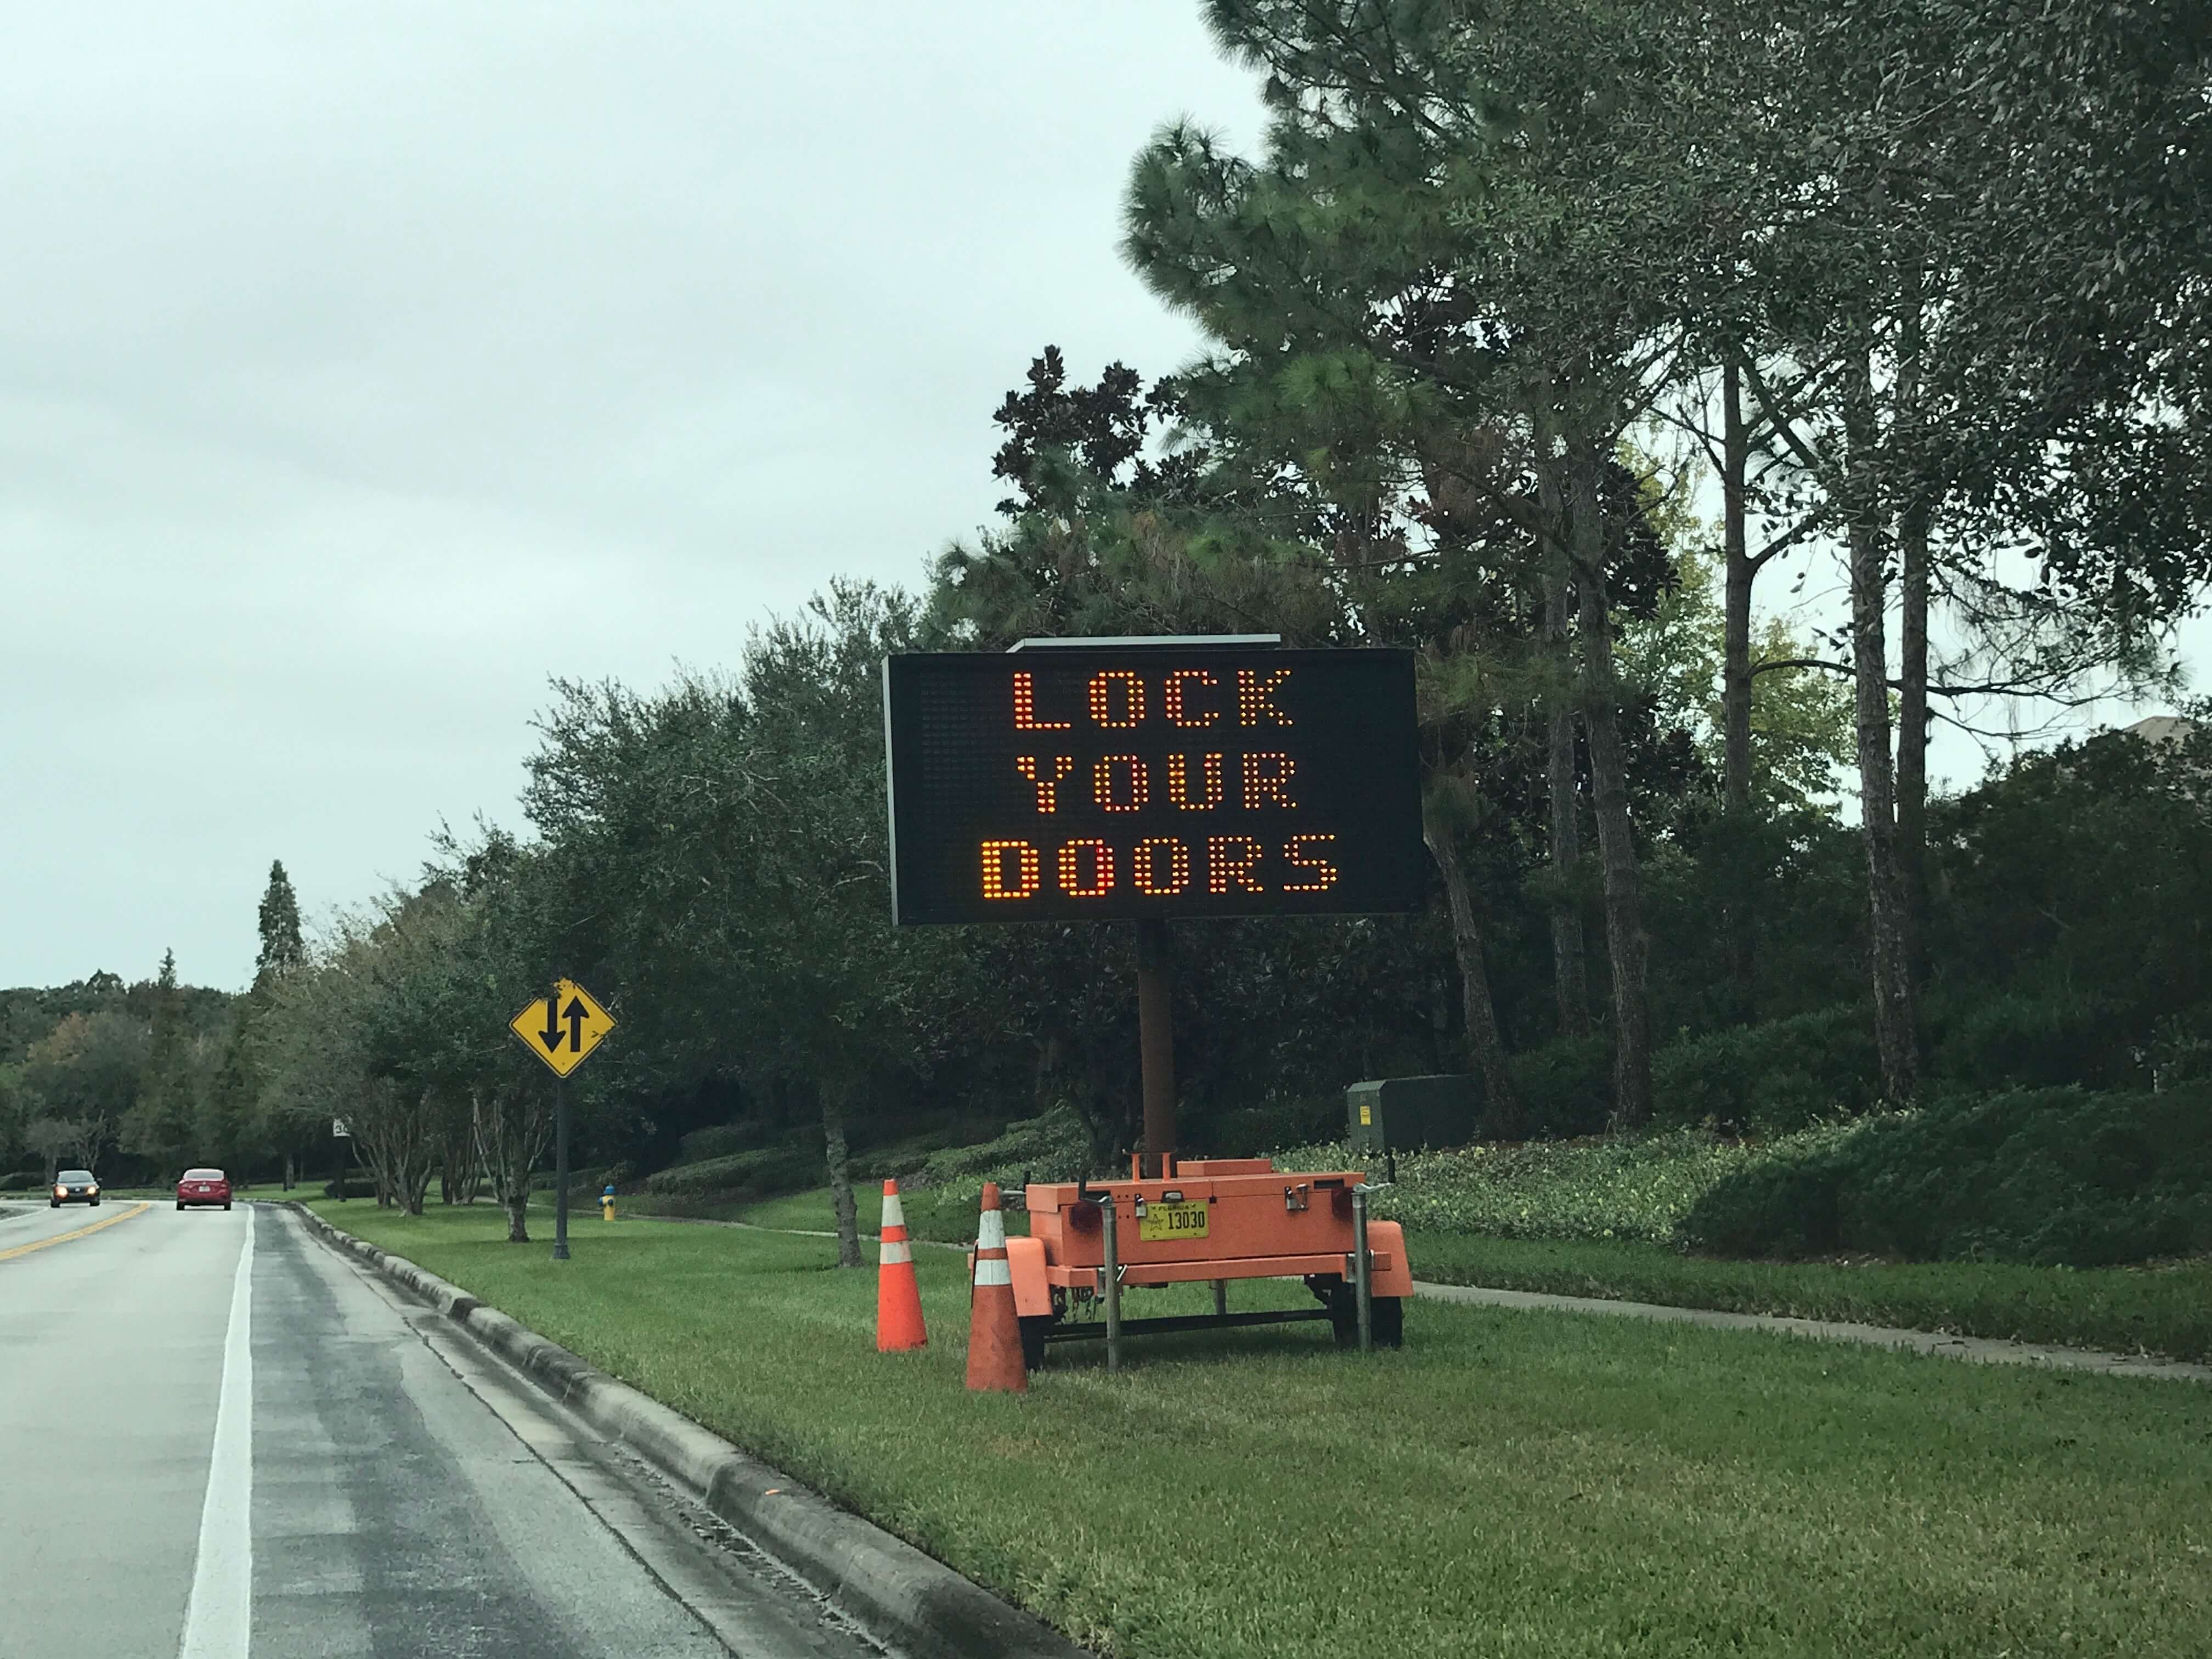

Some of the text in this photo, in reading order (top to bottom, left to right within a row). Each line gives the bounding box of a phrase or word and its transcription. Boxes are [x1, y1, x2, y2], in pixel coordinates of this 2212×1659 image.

[1014, 669, 1294, 729] LOCK
[1016, 752, 1297, 813] YOUR
[980, 833, 1338, 899] DOORS
[1168, 1211, 1205, 1230] 13030
